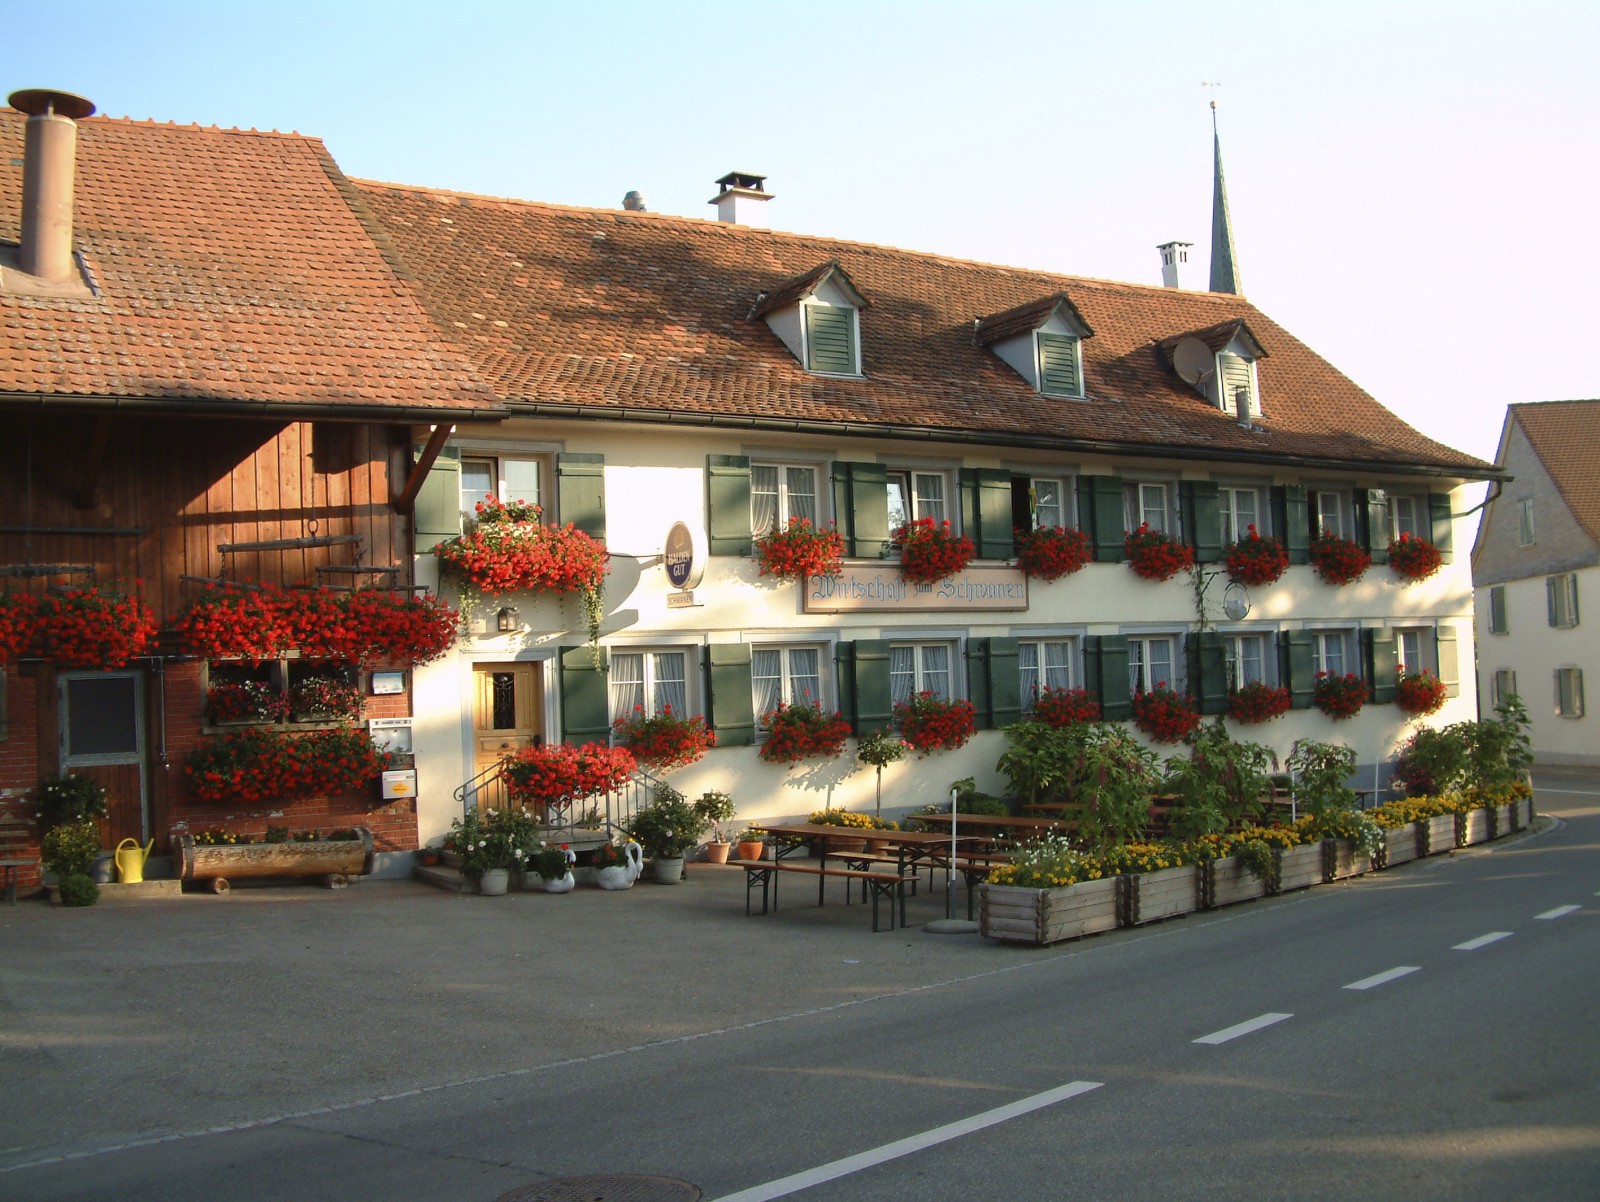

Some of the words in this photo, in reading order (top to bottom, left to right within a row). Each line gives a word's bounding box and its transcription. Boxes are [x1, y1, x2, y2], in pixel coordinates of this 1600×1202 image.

[668, 551, 690, 565] HALDEN
[673, 564, 686, 577] GUT
[812, 574, 907, 602] Wirtschaft
[914, 581, 933, 596] zum
[937, 574, 1024, 602] Schwanen
